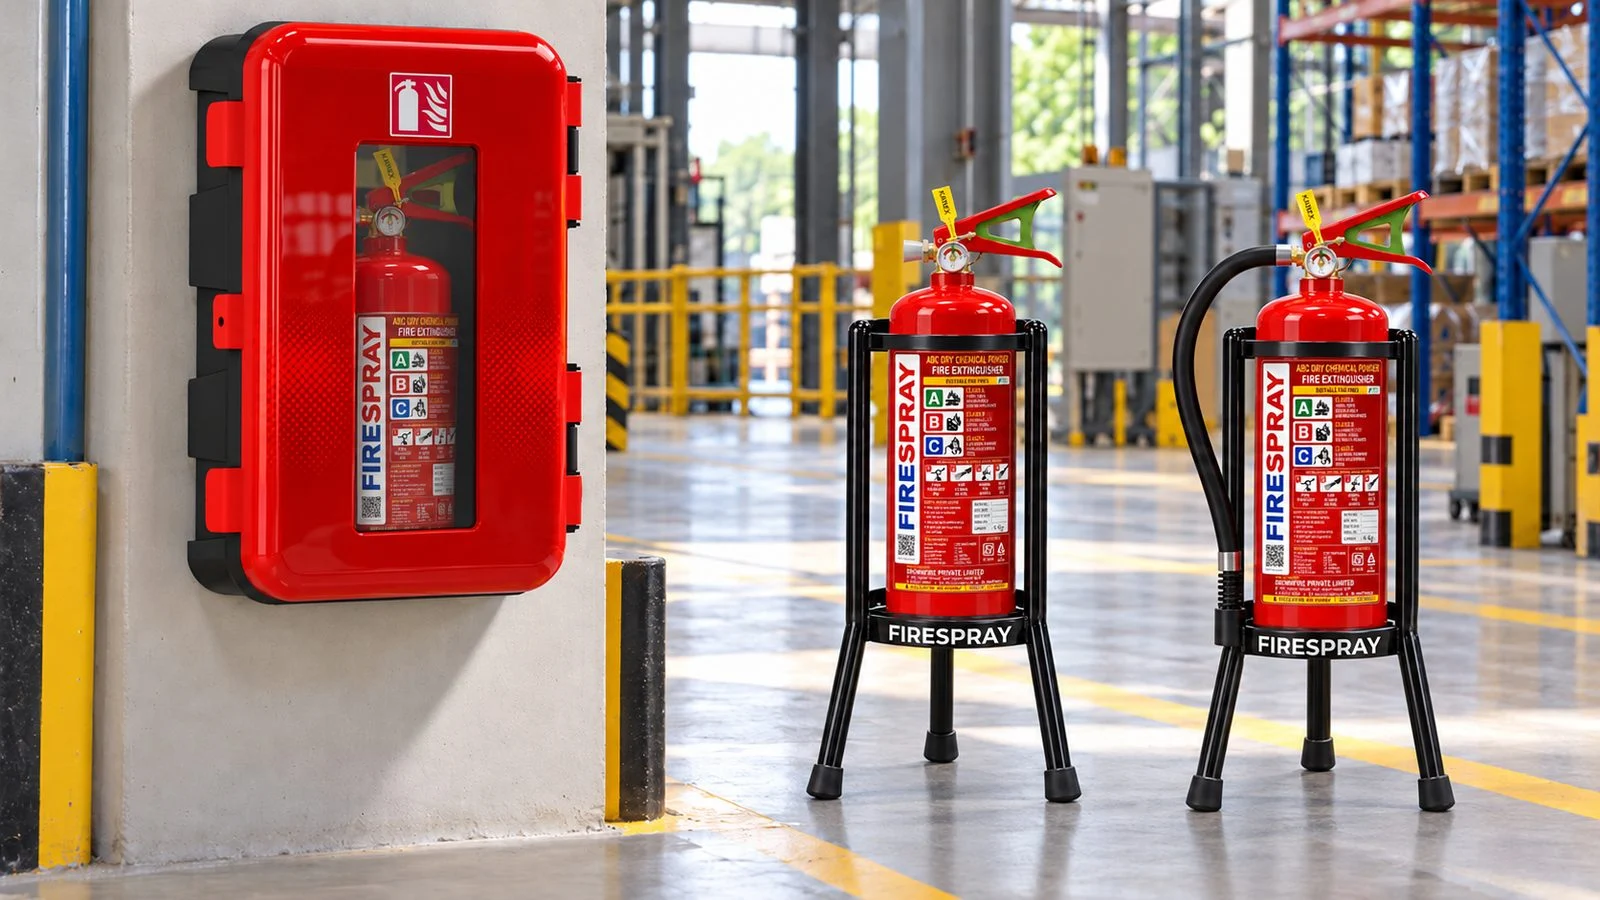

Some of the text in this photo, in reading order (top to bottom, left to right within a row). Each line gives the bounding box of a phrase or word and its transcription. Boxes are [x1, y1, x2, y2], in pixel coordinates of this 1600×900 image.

[398, 327, 416, 336] FIRE
[395, 353, 407, 366] A
[926, 355, 938, 364] ABC
[932, 365, 1004, 375] FIRE EXTINGUISHER
[1296, 364, 1310, 372] ABC
[396, 377, 407, 391] B
[1302, 374, 1375, 384] FIRE EXTINGUISHER
[928, 391, 941, 405] A
[361, 325, 381, 490] FIRESPRAY
[395, 402, 407, 415] C
[1298, 401, 1310, 415] A
[929, 416, 939, 429] B
[1298, 426, 1309, 439] B
[898, 362, 915, 530] FIRESPRAY
[928, 440, 940, 452] C
[1266, 371, 1284, 541] FIRESPRAY
[1298, 450, 1309, 463] C
[889, 624, 1012, 645] FIRESPRAY
[1258, 635, 1381, 656] FIRESPRAY
